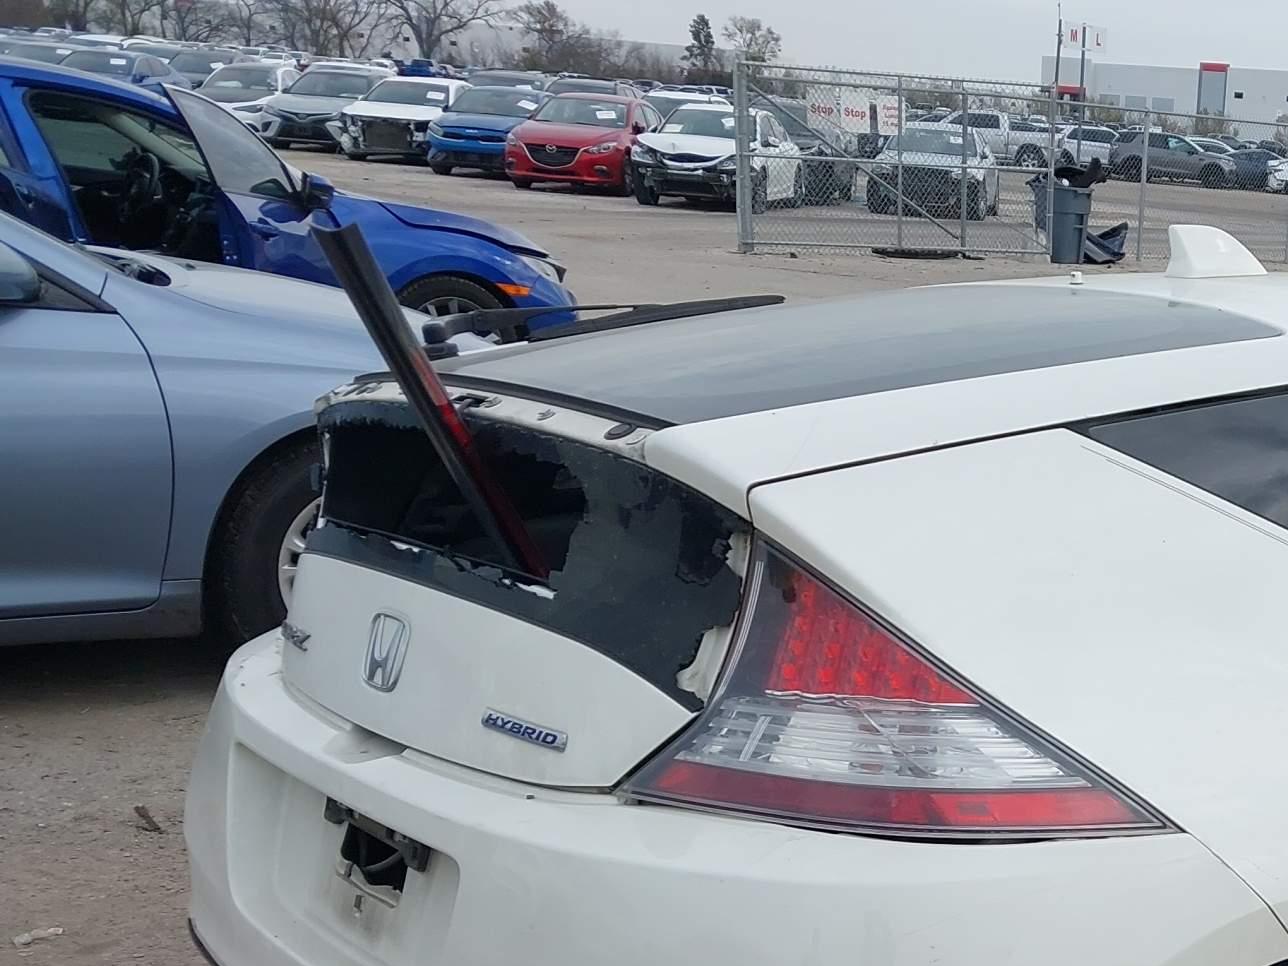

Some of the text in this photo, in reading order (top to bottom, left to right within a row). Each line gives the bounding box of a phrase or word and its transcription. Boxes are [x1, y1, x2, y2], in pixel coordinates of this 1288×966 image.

[1070, 29, 1078, 43] M
[1095, 32, 1102, 47] L
[810, 103, 834, 116] Stop
[844, 106, 867, 121] Stop
[485, 713, 558, 745] HYBRID
